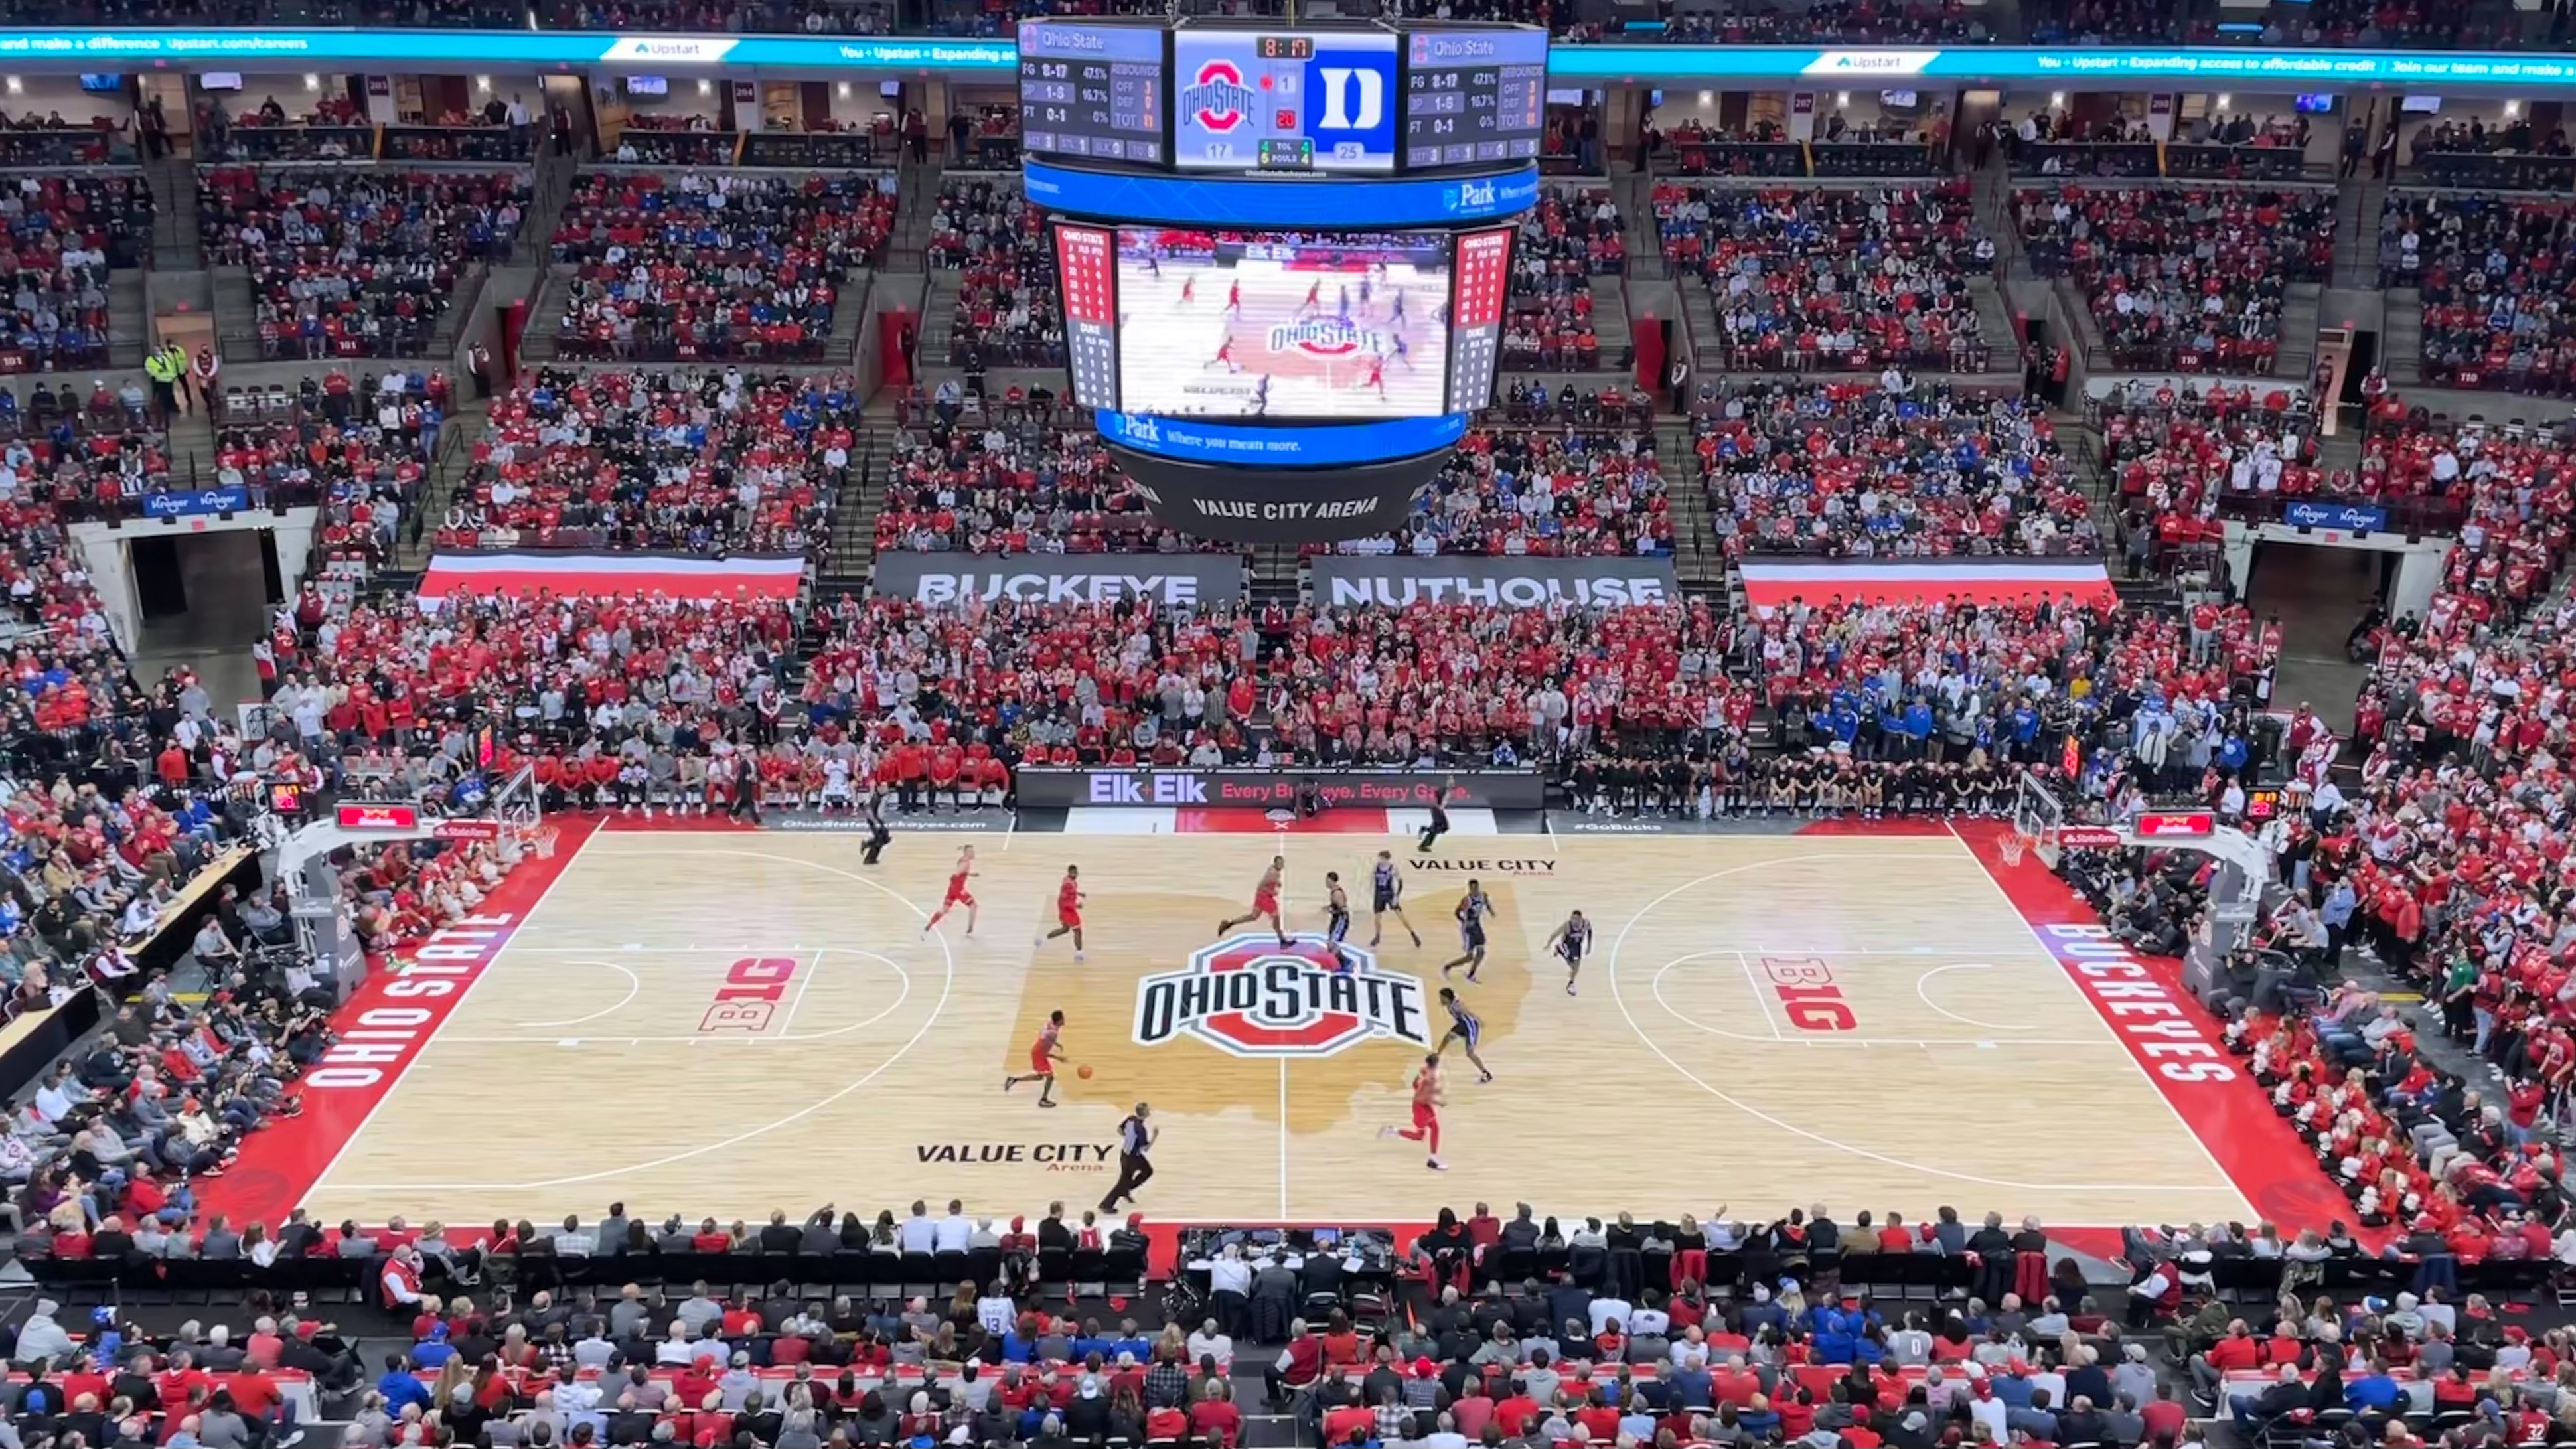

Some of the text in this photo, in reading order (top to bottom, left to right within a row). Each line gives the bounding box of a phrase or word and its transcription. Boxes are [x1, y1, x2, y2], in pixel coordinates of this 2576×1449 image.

[0, 37, 28, 50] and
[31, 37, 72, 50] make
[86, 35, 160, 50] difference
[1042, 31, 1104, 50] Ohio State
[1265, 38, 1306, 57] 8:17
[1434, 40, 1494, 56] Ohio State
[652, 44, 700, 55] Upstart
[839, 46, 864, 58] You
[874, 48, 921, 60] Upstart
[932, 48, 1000, 62] Expanding
[1022, 64, 1035, 75] FG
[1853, 57, 1900, 68] Upstart
[2038, 57, 2375, 72] You Upstart Expanding access to affordable credit
[2392, 60, 2422, 72] Join
[2424, 63, 2449, 73] our
[2451, 62, 2488, 74] team
[2491, 62, 2520, 74] and
[2522, 63, 2562, 76] make
[1116, 81, 1134, 92] OFF
[1411, 76, 1424, 88] FG
[1503, 83, 1520, 94] OFF
[737, 88, 753, 97] 204
[1023, 106, 1035, 117] FT
[1114, 114, 1136, 126] TOT
[1410, 121, 1422, 133] FT
[1501, 115, 1520, 126] TOT
[1210, 143, 1227, 159] 17
[1339, 145, 1357, 160] 25
[1301, 154, 1310, 164] 4
[1460, 181, 1495, 206] Park
[339, 341, 356, 350] 101
[679, 346, 696, 354] 104
[3, 356, 22, 366] 101
[1851, 355, 1867, 365] 107
[1125, 414, 1160, 443] Park
[1167, 430, 1203, 448] Where
[1205, 433, 1226, 449] you
[1228, 436, 1263, 451] mean
[1266, 437, 1301, 452] more.
[151, 491, 236, 513] Kroger Kroger
[1193, 496, 1379, 520] VALUE CITY ARENA
[2293, 504, 2376, 528] Kroger Kroger
[917, 573, 1198, 605] BUCKEYE
[1331, 576, 1664, 607] NUTHOUSE
[1221, 783, 1270, 800] Every
[1361, 783, 1410, 800] Every
[1410, 860, 1556, 871] VALUE CITY
[304, 913, 513, 1087] OHIO STATE
[1140, 964, 1423, 1042] OHIO STATE
[2045, 923, 2237, 1082] BUCKEYES
[917, 1144, 1114, 1163] VALUE CITY
[1047, 1162, 1104, 1172] Arena
[985, 1317, 1000, 1333] 13
[1911, 1338, 1922, 1356] 0
[2528, 1423, 2545, 1437] 32
